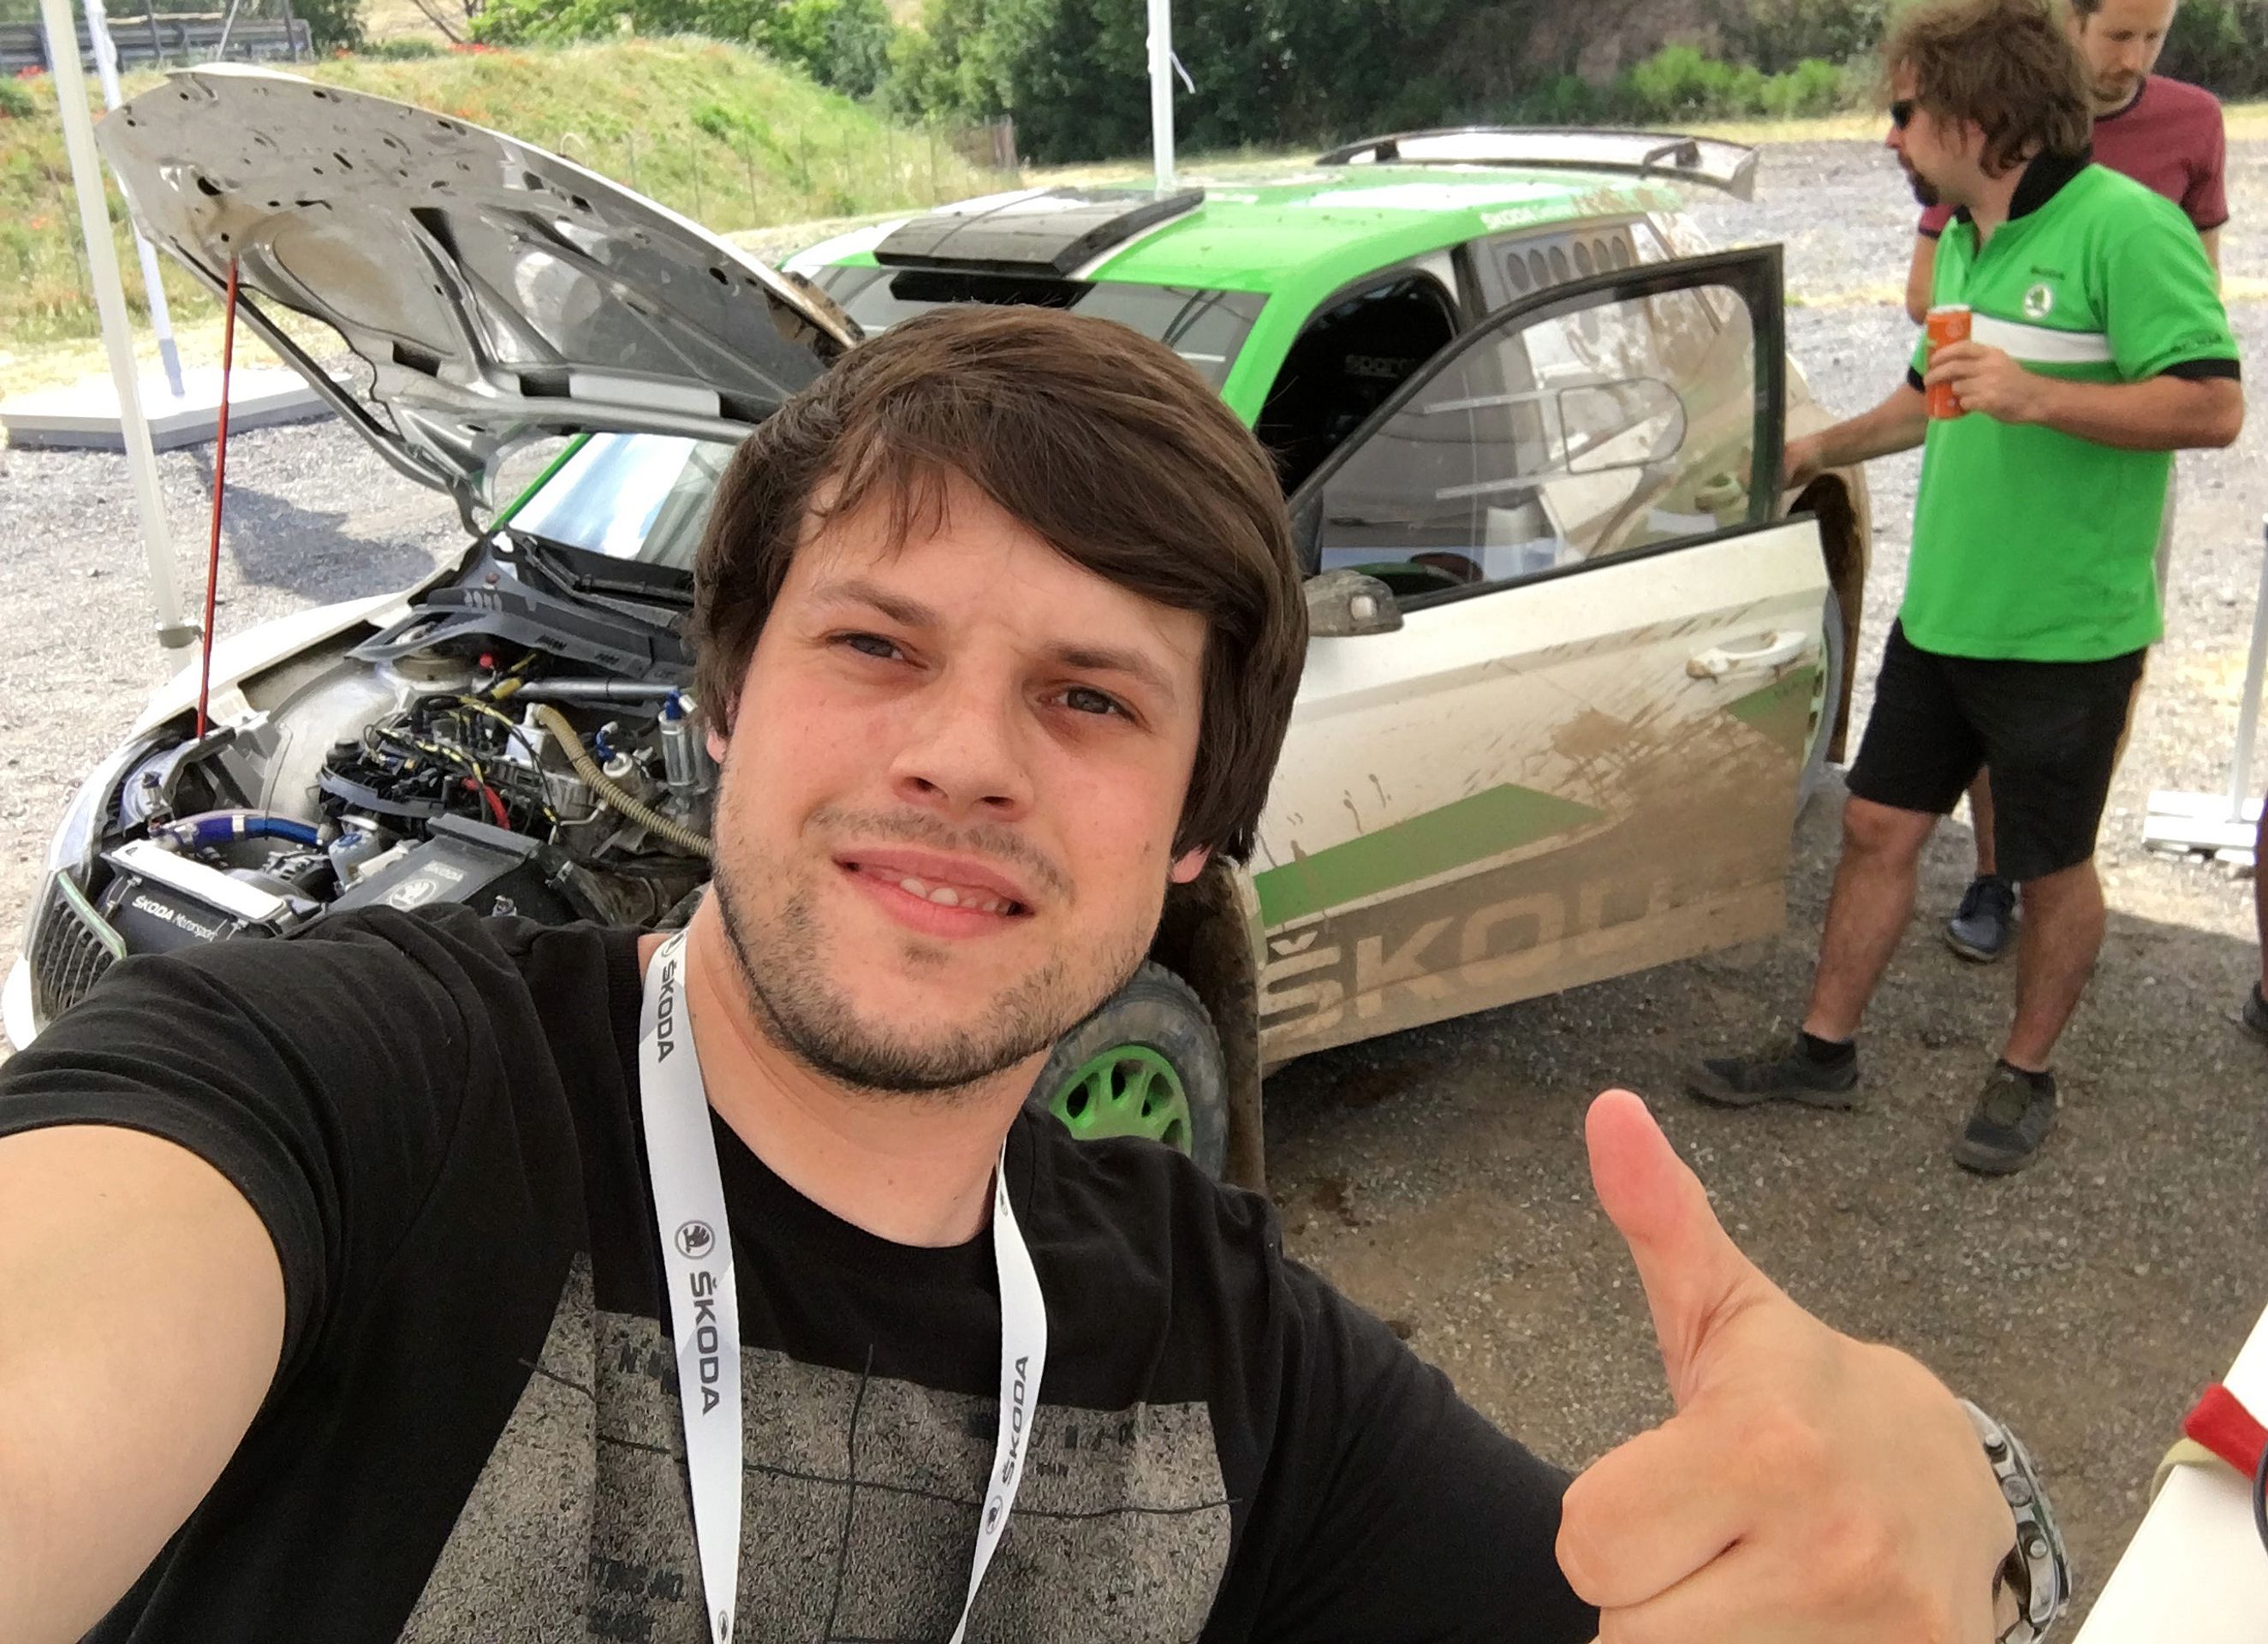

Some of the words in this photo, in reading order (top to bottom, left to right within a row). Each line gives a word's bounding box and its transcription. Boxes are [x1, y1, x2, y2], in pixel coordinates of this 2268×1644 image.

[658, 959, 677, 1063] ŠKODA
[689, 1271, 720, 1416] ŠKODA
[1002, 1355, 1029, 1487] ŠKODA
